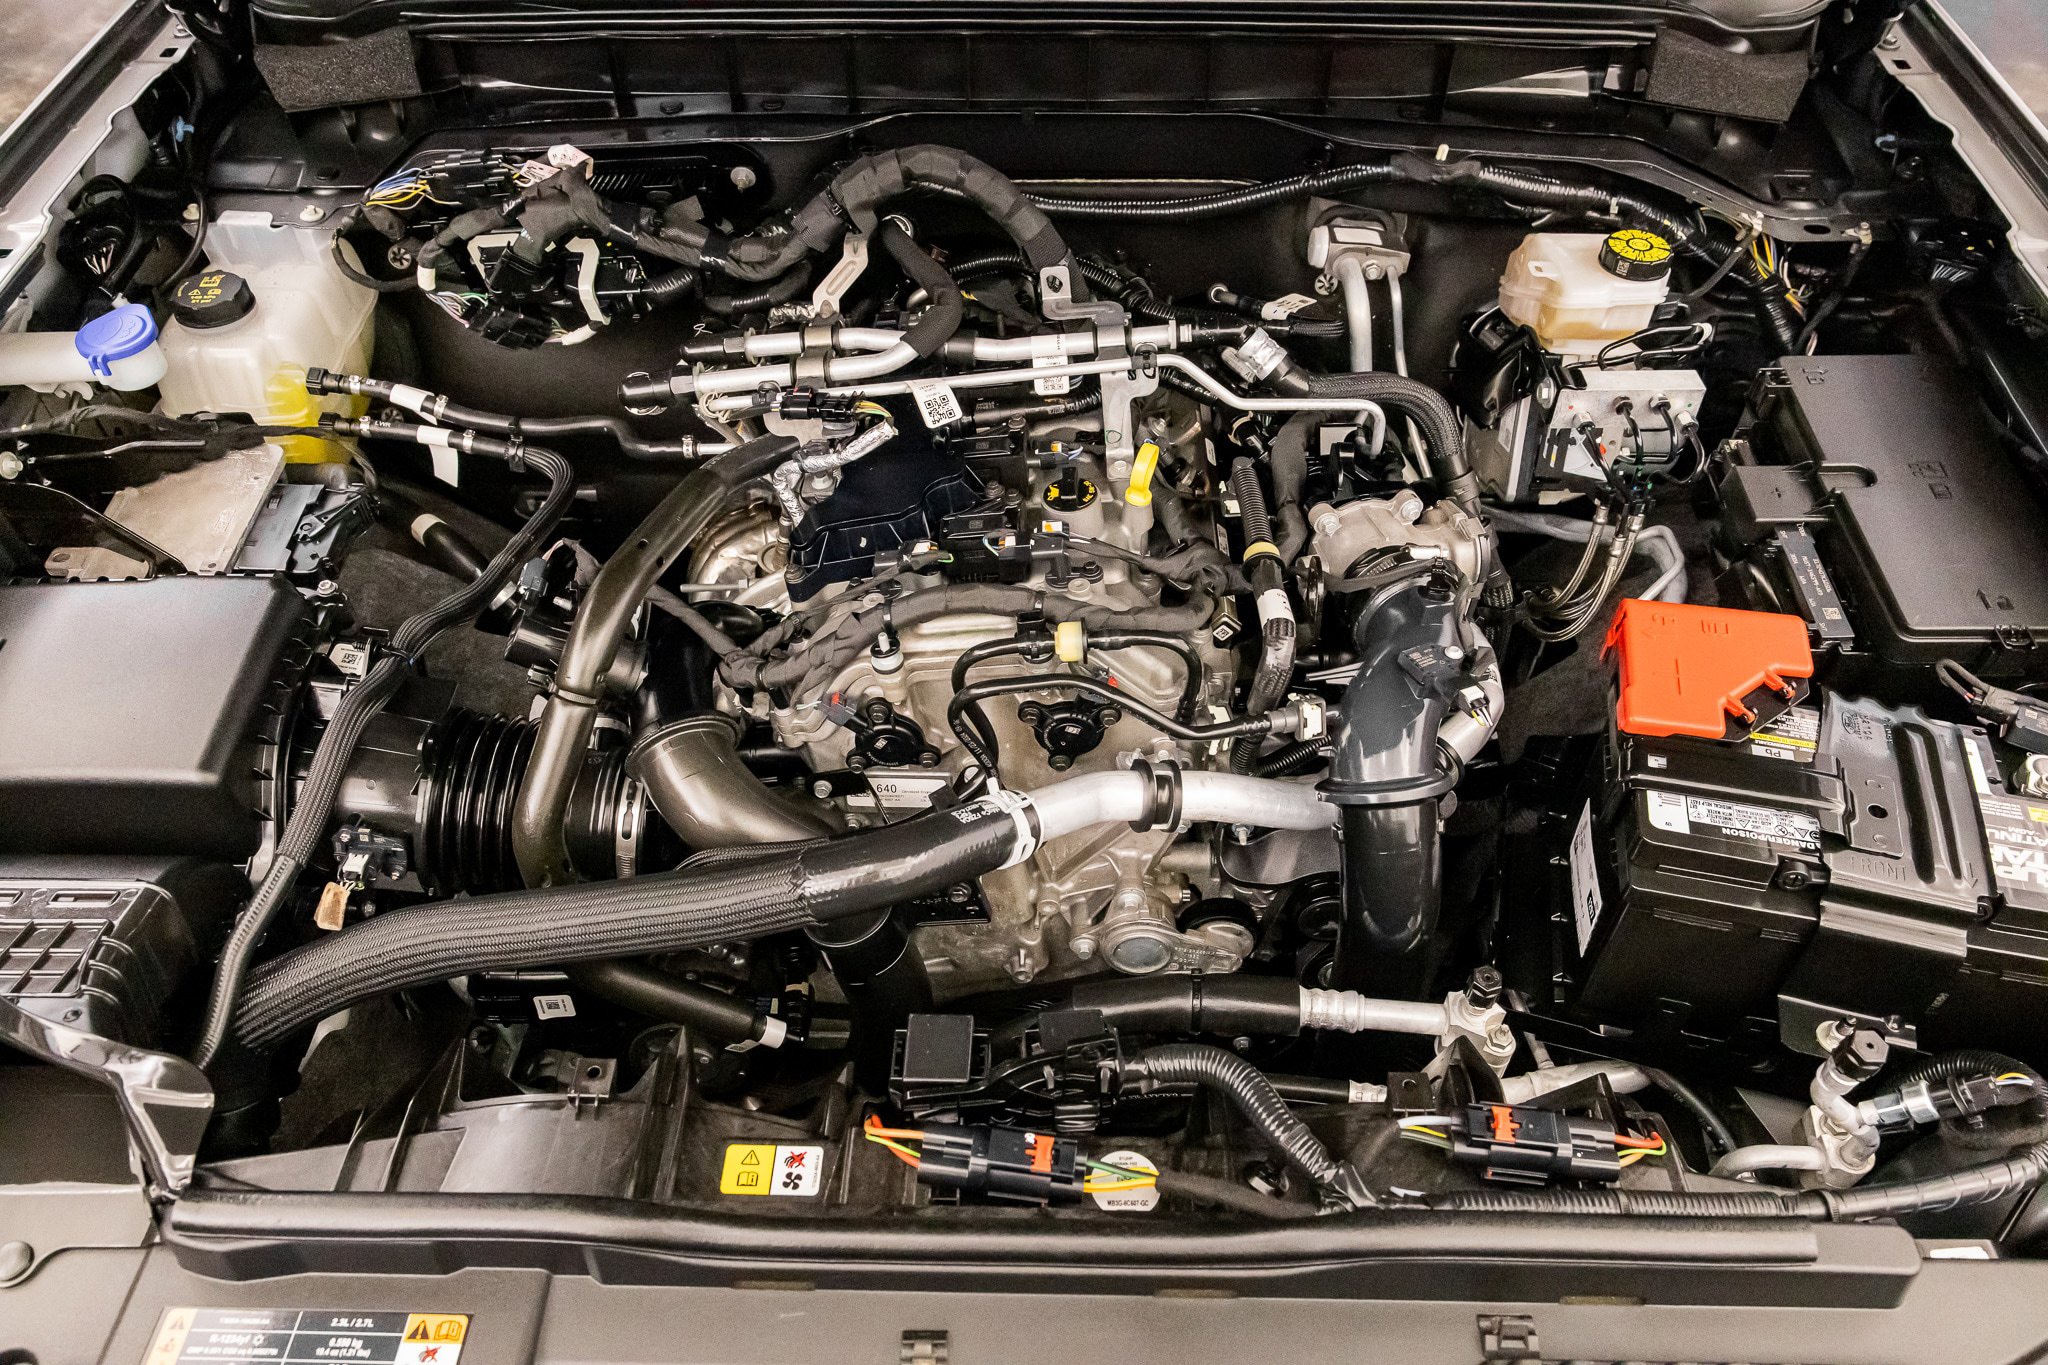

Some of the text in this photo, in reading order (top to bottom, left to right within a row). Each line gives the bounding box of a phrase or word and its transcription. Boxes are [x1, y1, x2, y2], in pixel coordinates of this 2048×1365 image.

[374, 420, 391, 428] LWR
[1765, 748, 1781, 757] Pb
[876, 783, 897, 794] 640
[2007, 826, 2032, 834] AGM
[1721, 827, 1816, 850] DANGER/POISON
[1851, 855, 1907, 882] FRONT
